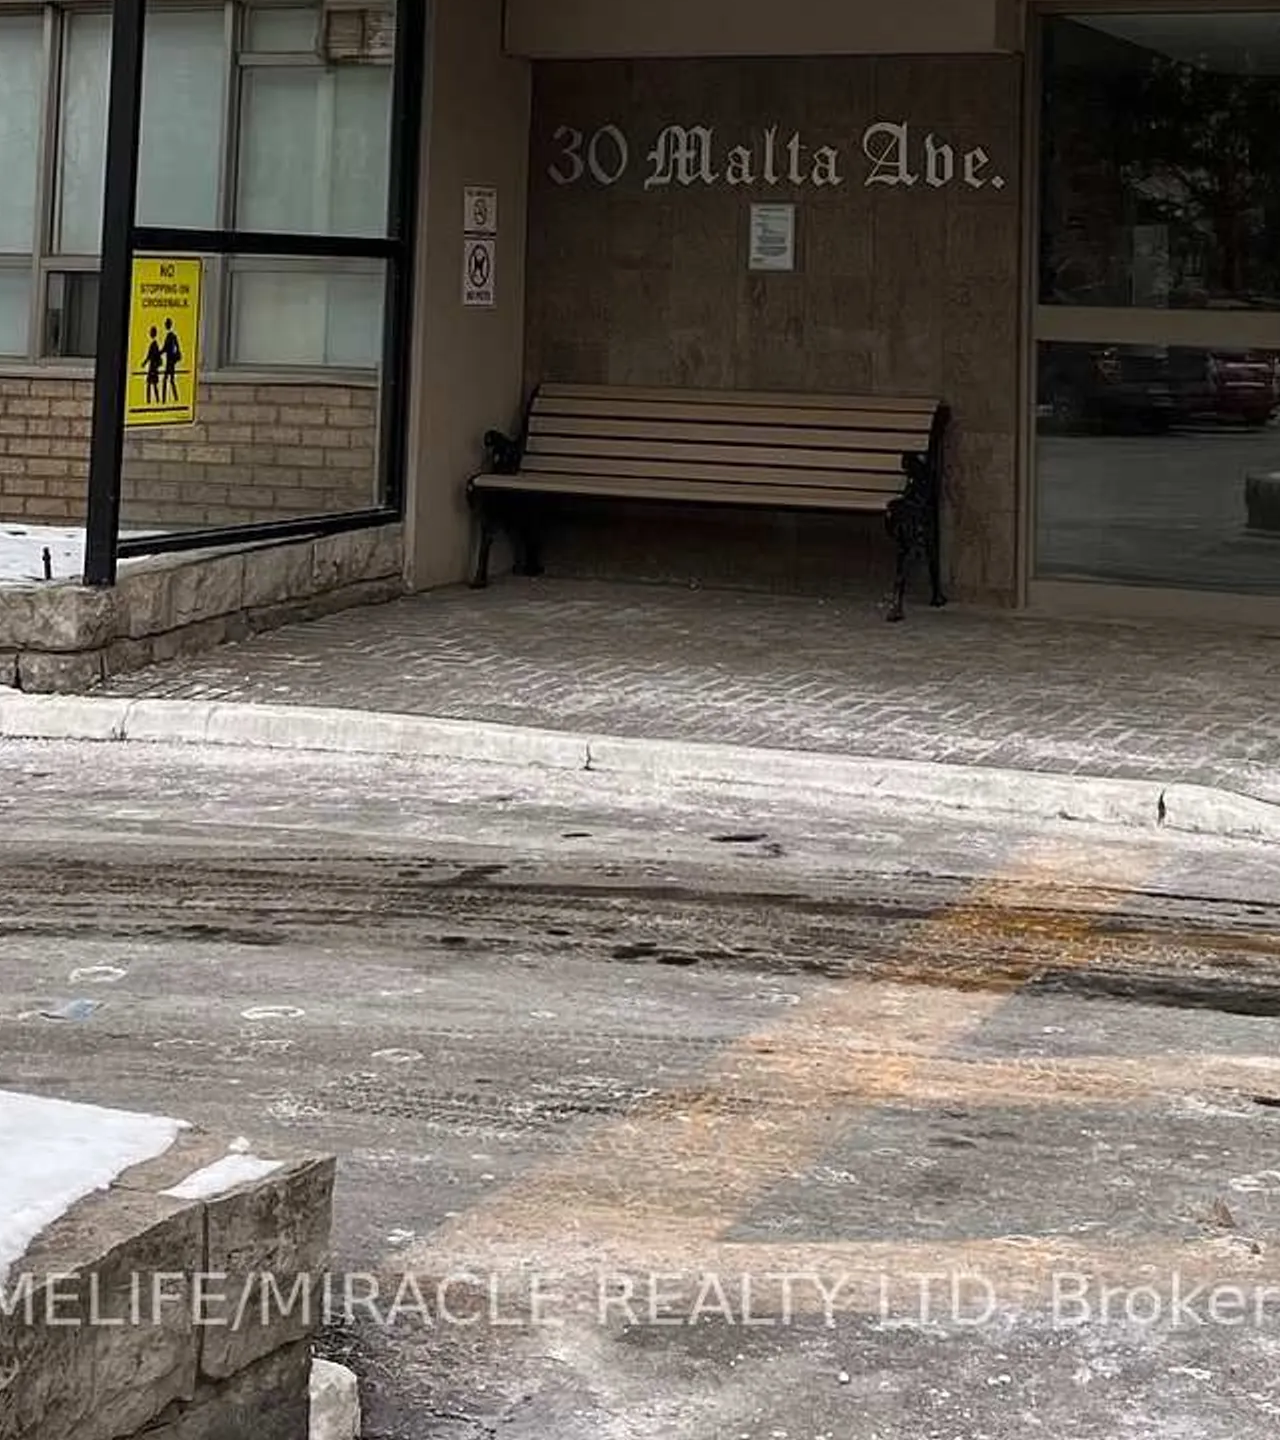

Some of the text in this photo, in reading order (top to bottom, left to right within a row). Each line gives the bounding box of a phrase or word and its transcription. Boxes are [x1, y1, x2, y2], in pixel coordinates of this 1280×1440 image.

[547, 121, 1007, 190] 30 Malta Ave.
